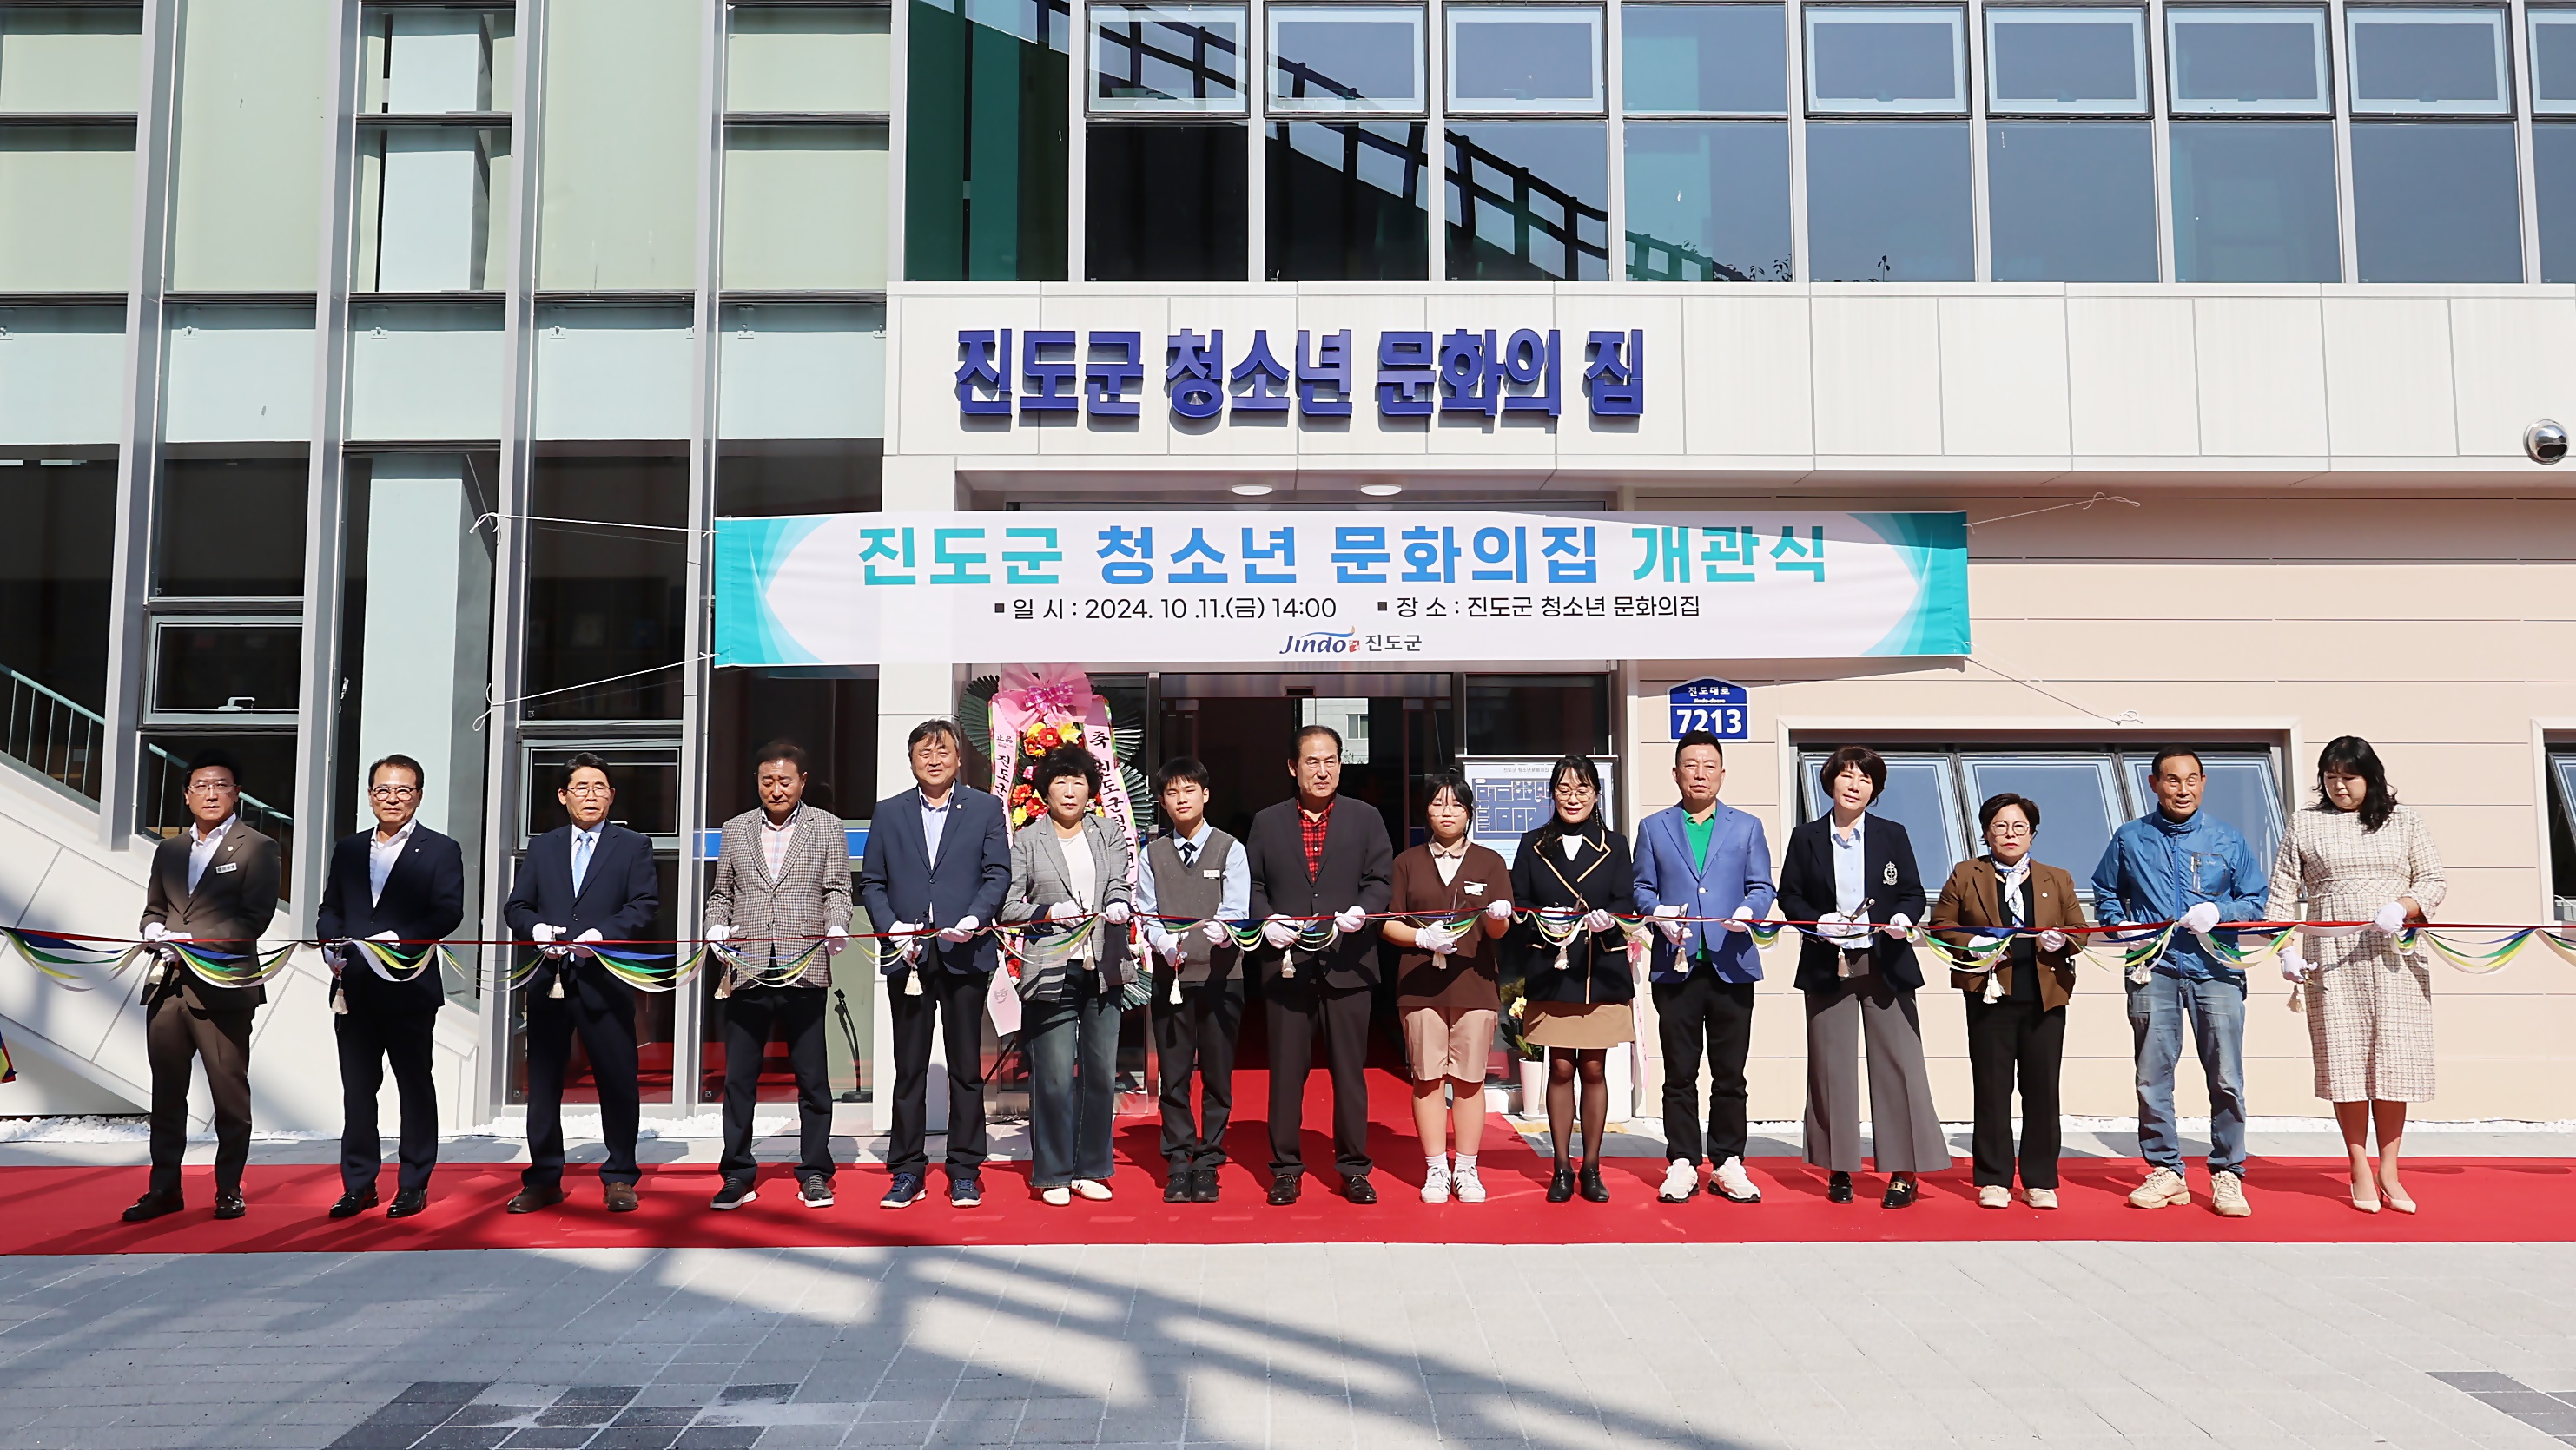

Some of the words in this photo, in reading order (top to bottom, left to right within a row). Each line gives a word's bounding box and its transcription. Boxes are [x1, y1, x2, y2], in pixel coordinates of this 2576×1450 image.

[955, 329, 1144, 417] 진도군
[1167, 329, 1353, 419] 청소년
[1377, 329, 1561, 418] 문화의
[1586, 329, 1643, 416] 집
[858, 526, 1064, 587] 진도군
[1096, 524, 1298, 586] 청소년
[1331, 524, 1598, 585] 문화의집
[1631, 525, 1826, 583] 개관식
[1013, 598, 1034, 620] 일
[1085, 598, 1153, 619] 2024.
[1160, 598, 1187, 619] 10
[1271, 597, 1337, 619] 14:00
[1397, 596, 1419, 618] 장
[1468, 596, 1533, 617] 진도군
[1541, 596, 1606, 617] 청소년
[1614, 596, 1700, 617] 문화의집
[1279, 635, 1347, 654] Jindo
[1364, 634, 1423, 652] 진도군
[1688, 686, 1731, 697] 진도대로
[1676, 709, 1742, 734] 7213
[1089, 731, 1110, 749] 축
